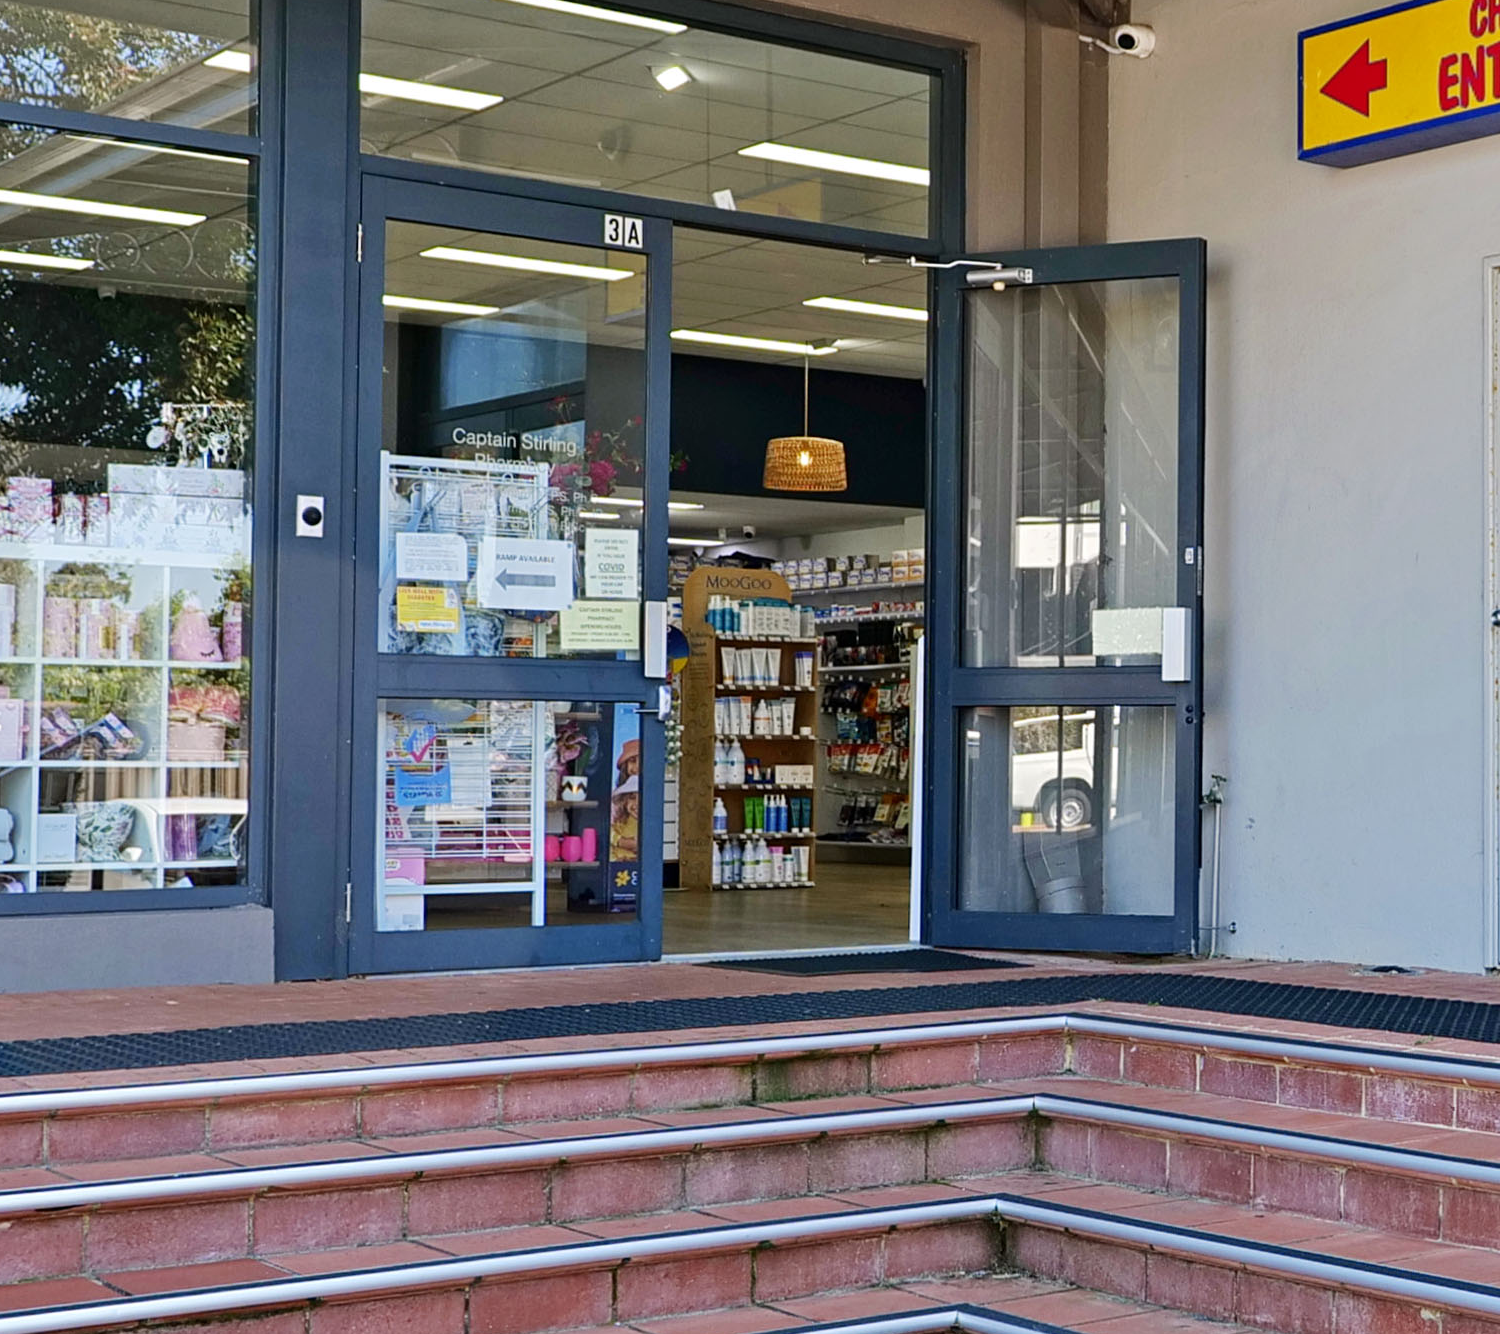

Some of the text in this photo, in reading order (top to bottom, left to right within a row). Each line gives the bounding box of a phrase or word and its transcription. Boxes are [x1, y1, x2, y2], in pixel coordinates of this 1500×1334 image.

[609, 218, 640, 245] 3A
[452, 427, 577, 457] Captain Stirling
[496, 554, 555, 564] RAMP AVAILABLE
[598, 563, 625, 572] COVID
[706, 575, 772, 590] MooGoo
